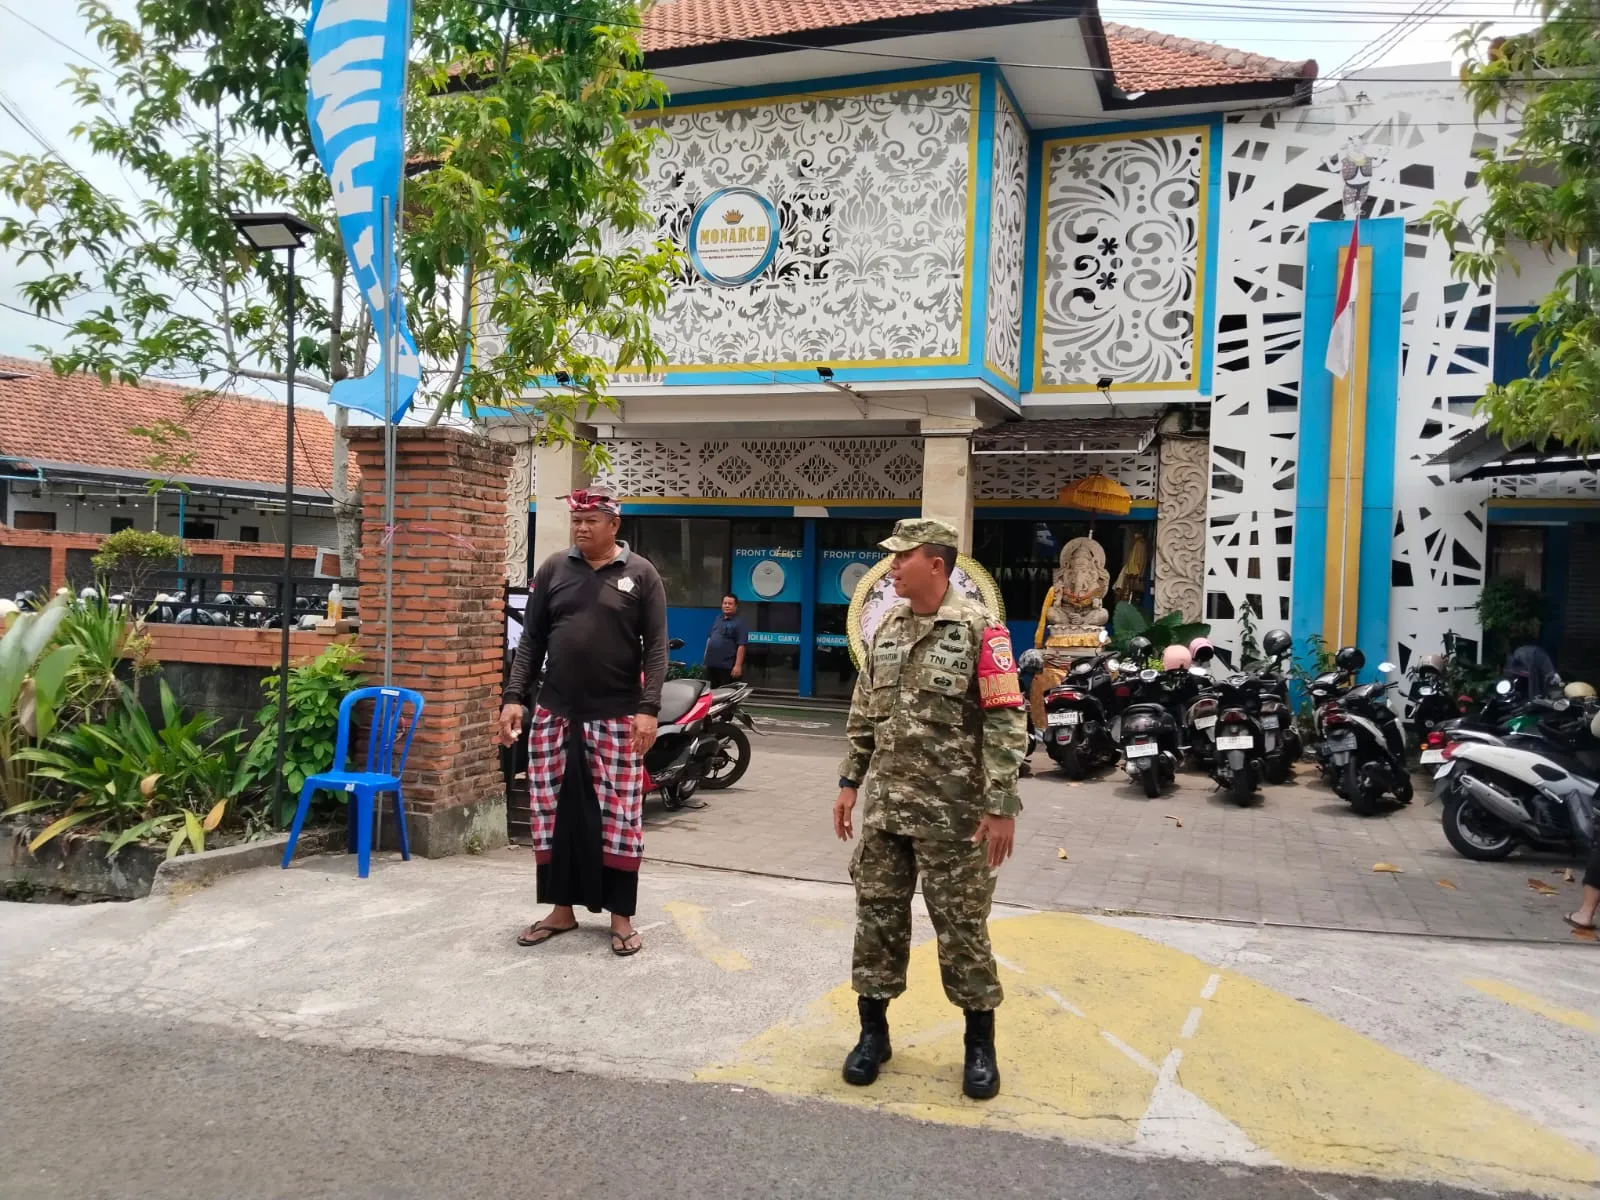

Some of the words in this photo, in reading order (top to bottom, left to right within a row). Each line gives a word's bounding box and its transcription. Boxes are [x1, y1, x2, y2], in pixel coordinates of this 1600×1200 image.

[700, 226, 766, 244] MONARCH
[735, 549, 767, 557] FRONT
[823, 551, 857, 559] FRONT
[929, 654, 947, 665] TNI
[951, 659, 968, 670] AD
